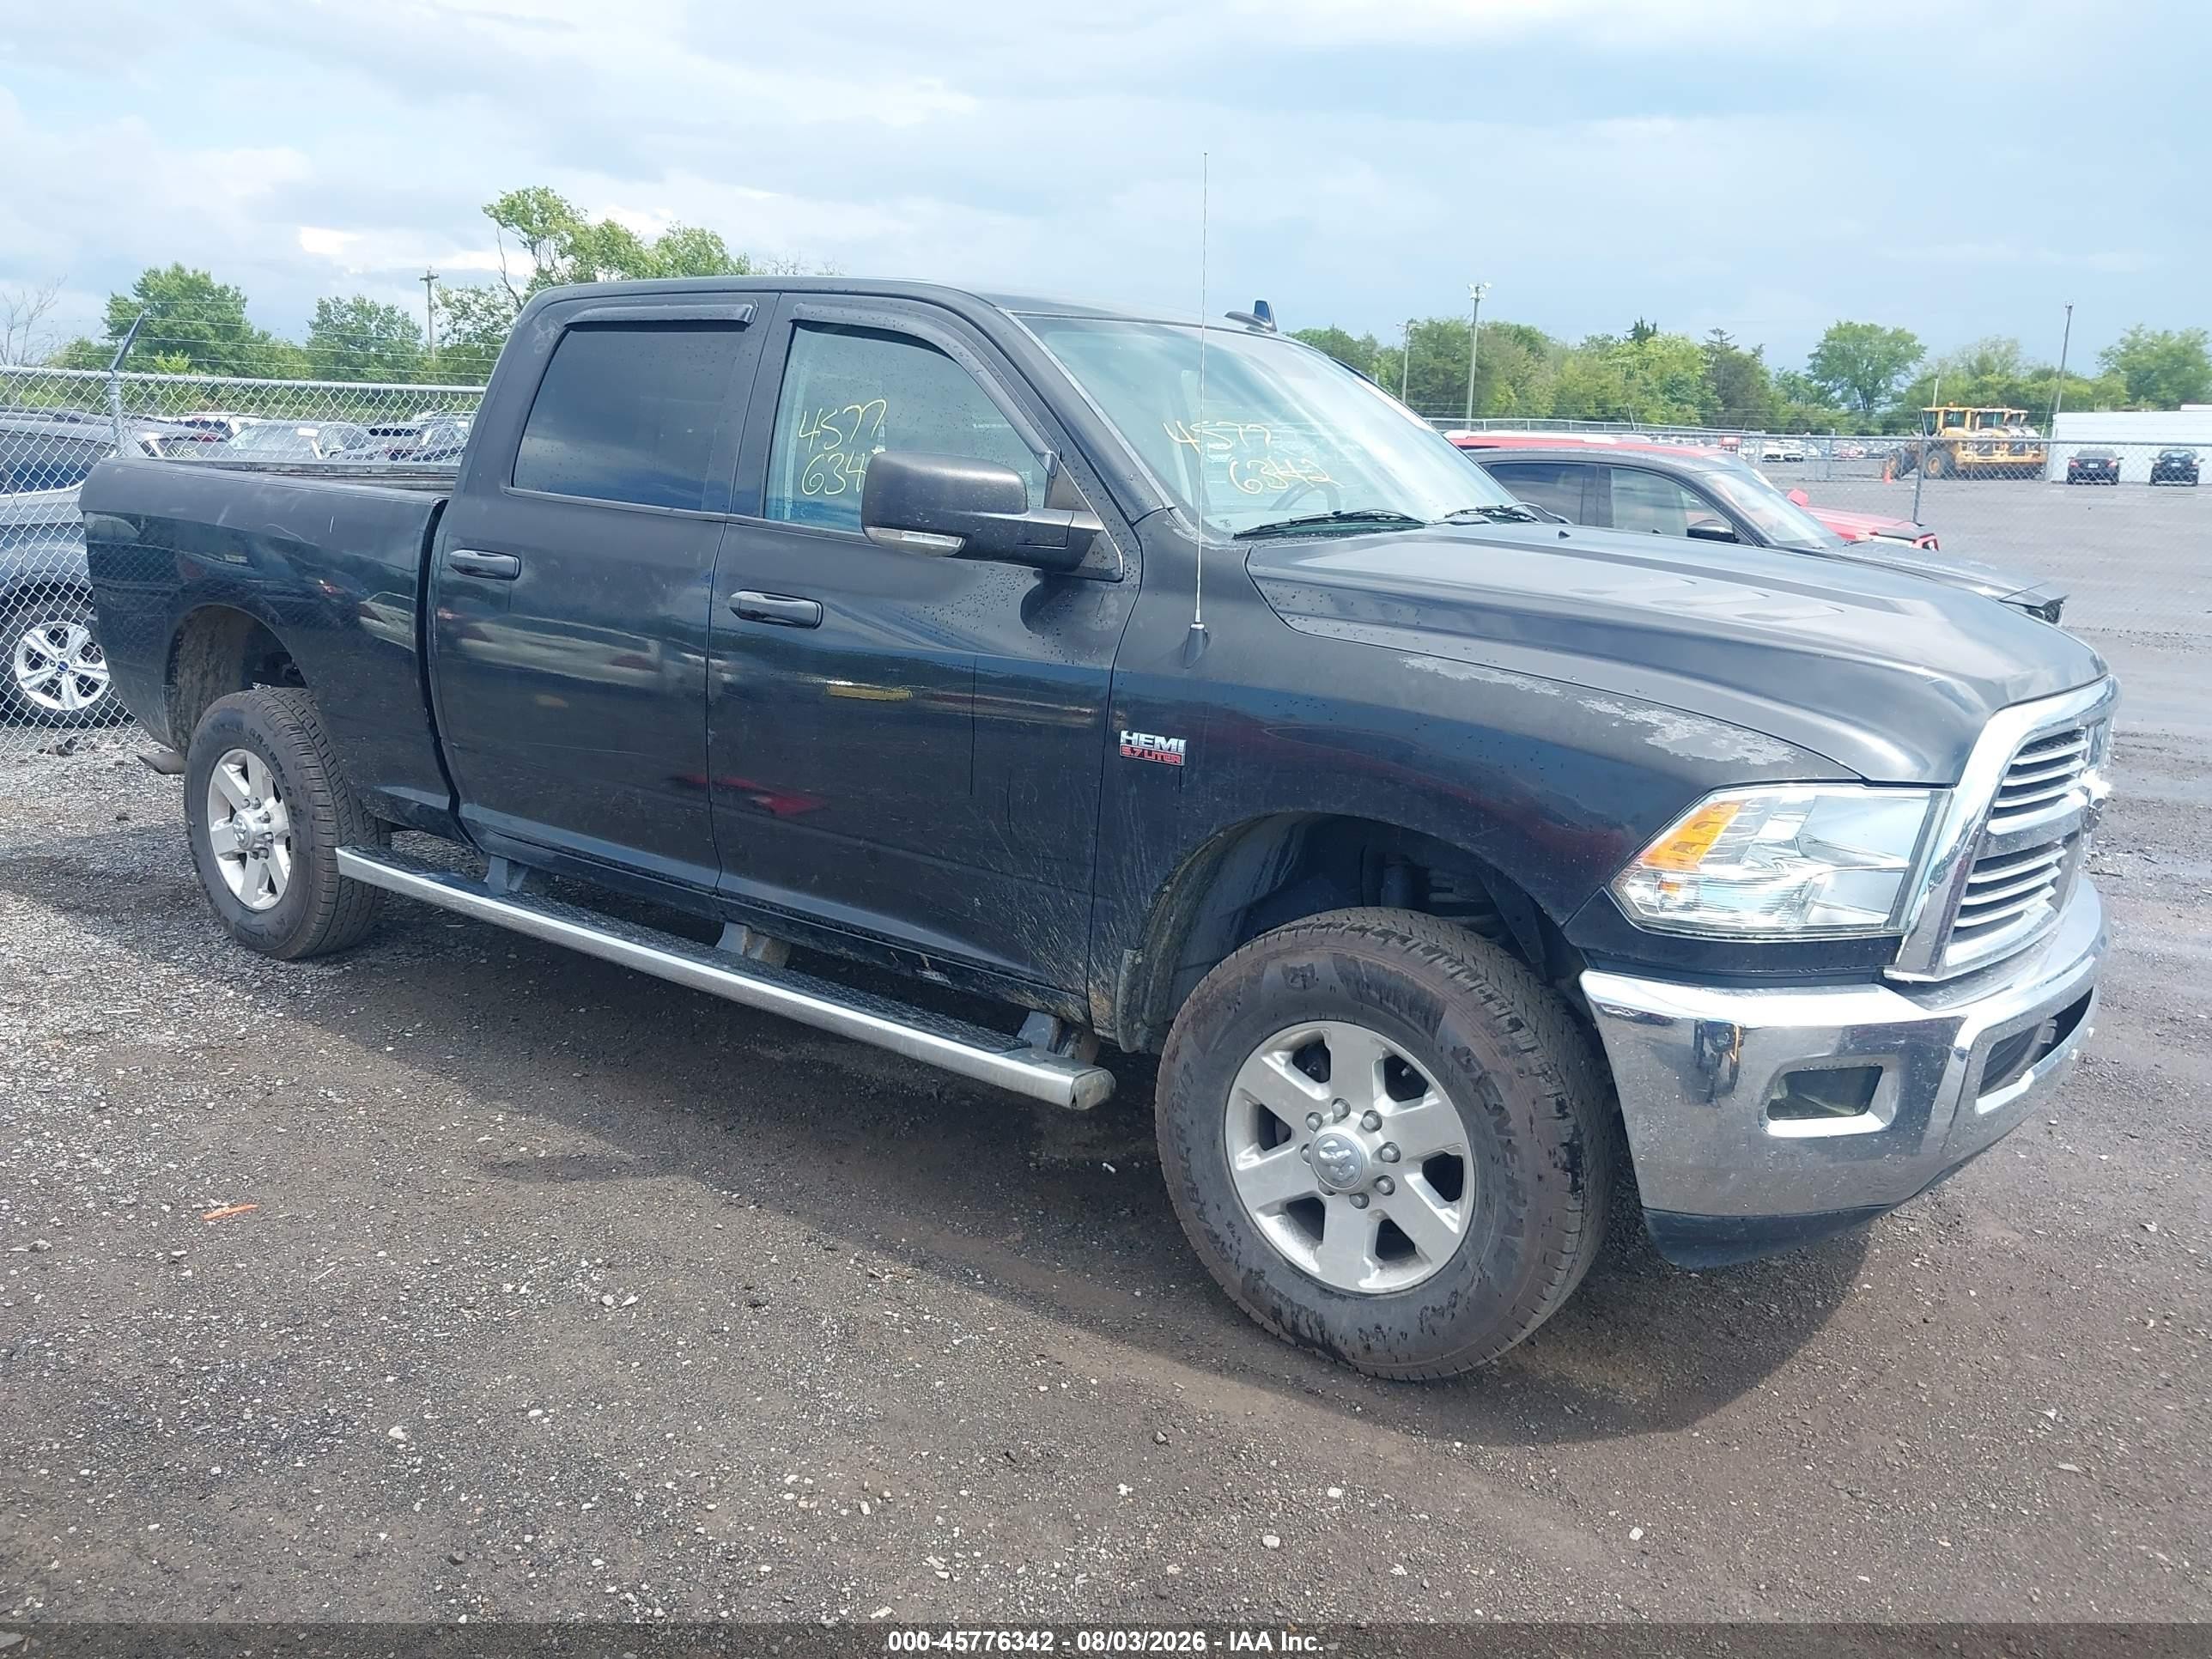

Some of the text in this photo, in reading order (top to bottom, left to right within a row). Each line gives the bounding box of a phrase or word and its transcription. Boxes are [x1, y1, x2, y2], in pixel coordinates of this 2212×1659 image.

[799, 399, 887, 453] 4577
[1163, 420, 1271, 454] 4577
[801, 451, 867, 496] 634
[1229, 456, 1346, 495] 6342
[1120, 730, 1187, 753] HEMI
[1121, 745, 1182, 764] 5.7 LITER
